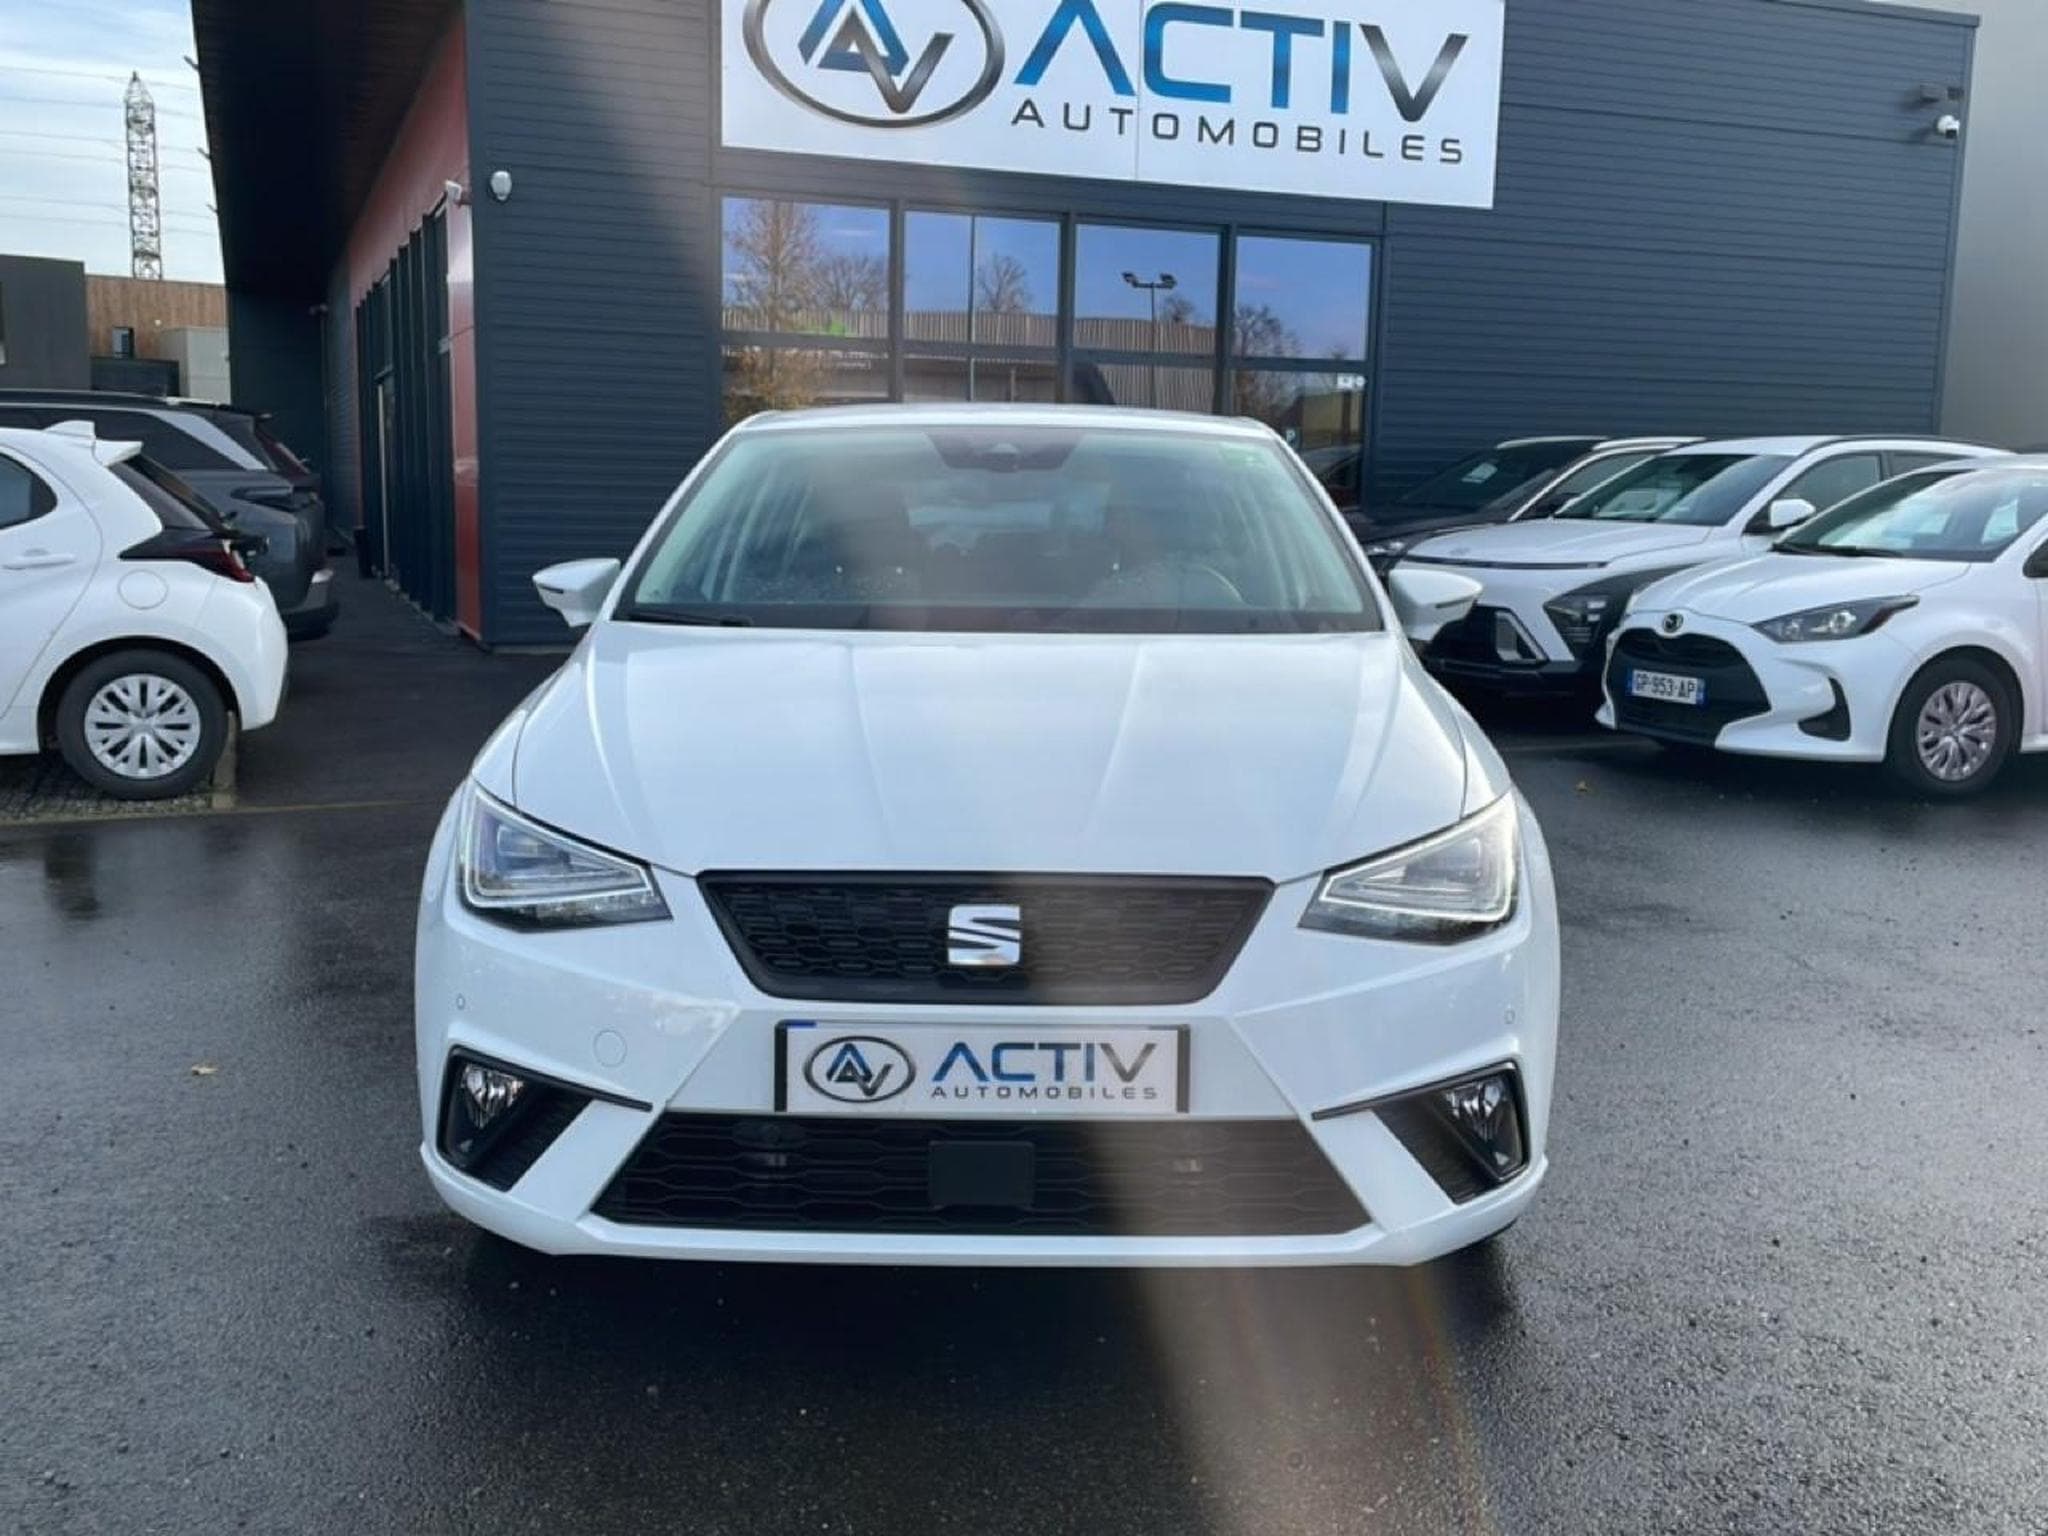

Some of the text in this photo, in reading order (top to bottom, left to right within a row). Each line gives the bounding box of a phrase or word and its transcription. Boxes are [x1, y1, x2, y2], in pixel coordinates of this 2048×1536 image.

[1013, 0, 1469, 123] ACTIV
[1010, 97, 1464, 165] AUTOMOBILES
[931, 1041, 1158, 1083] ACTIV
[931, 1086, 1158, 1100] AUTOMOBILES
